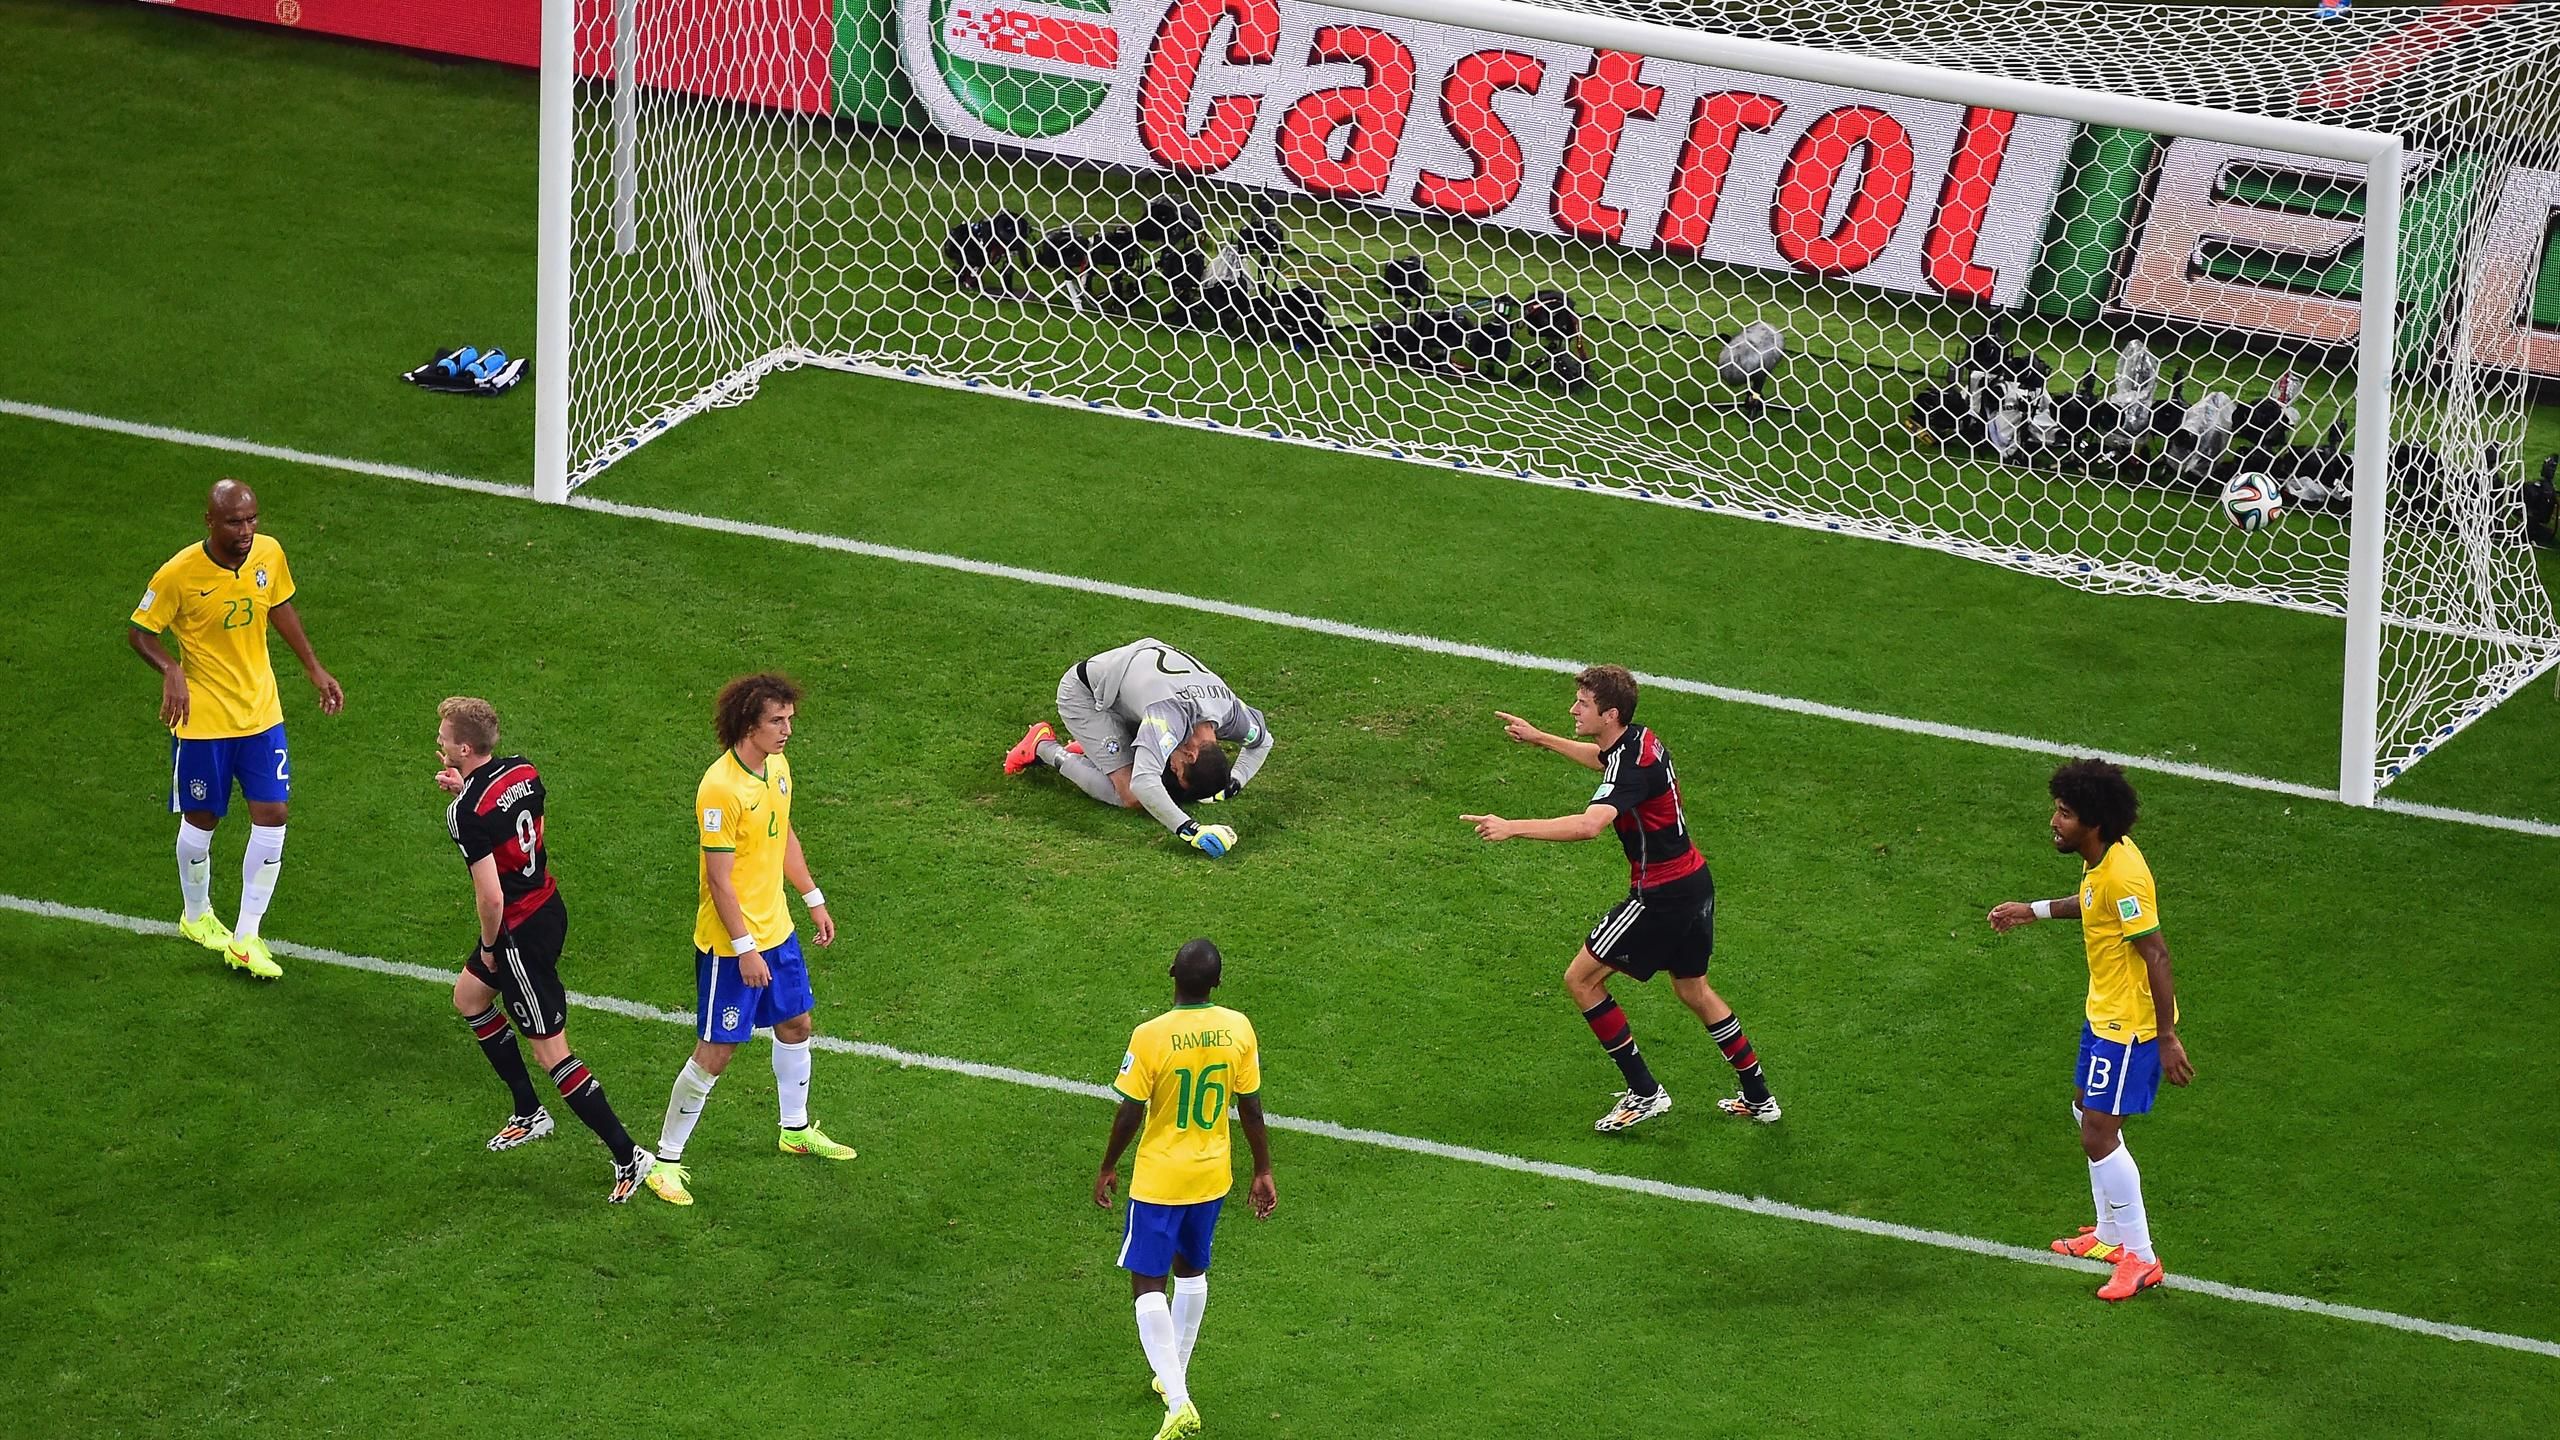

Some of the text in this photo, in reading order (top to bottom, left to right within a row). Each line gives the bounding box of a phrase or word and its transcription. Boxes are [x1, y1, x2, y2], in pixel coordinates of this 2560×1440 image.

[1136, 0, 2017, 304] Castrol
[223, 598, 254, 630] 23
[274, 748, 289, 780] 2
[768, 811, 779, 839] 4
[516, 809, 537, 877] 9
[512, 1001, 531, 1028] 9
[1171, 1029, 1233, 1051] RAMIRES
[2087, 1055, 2112, 1089] 13
[1174, 1062, 1229, 1131] 16
